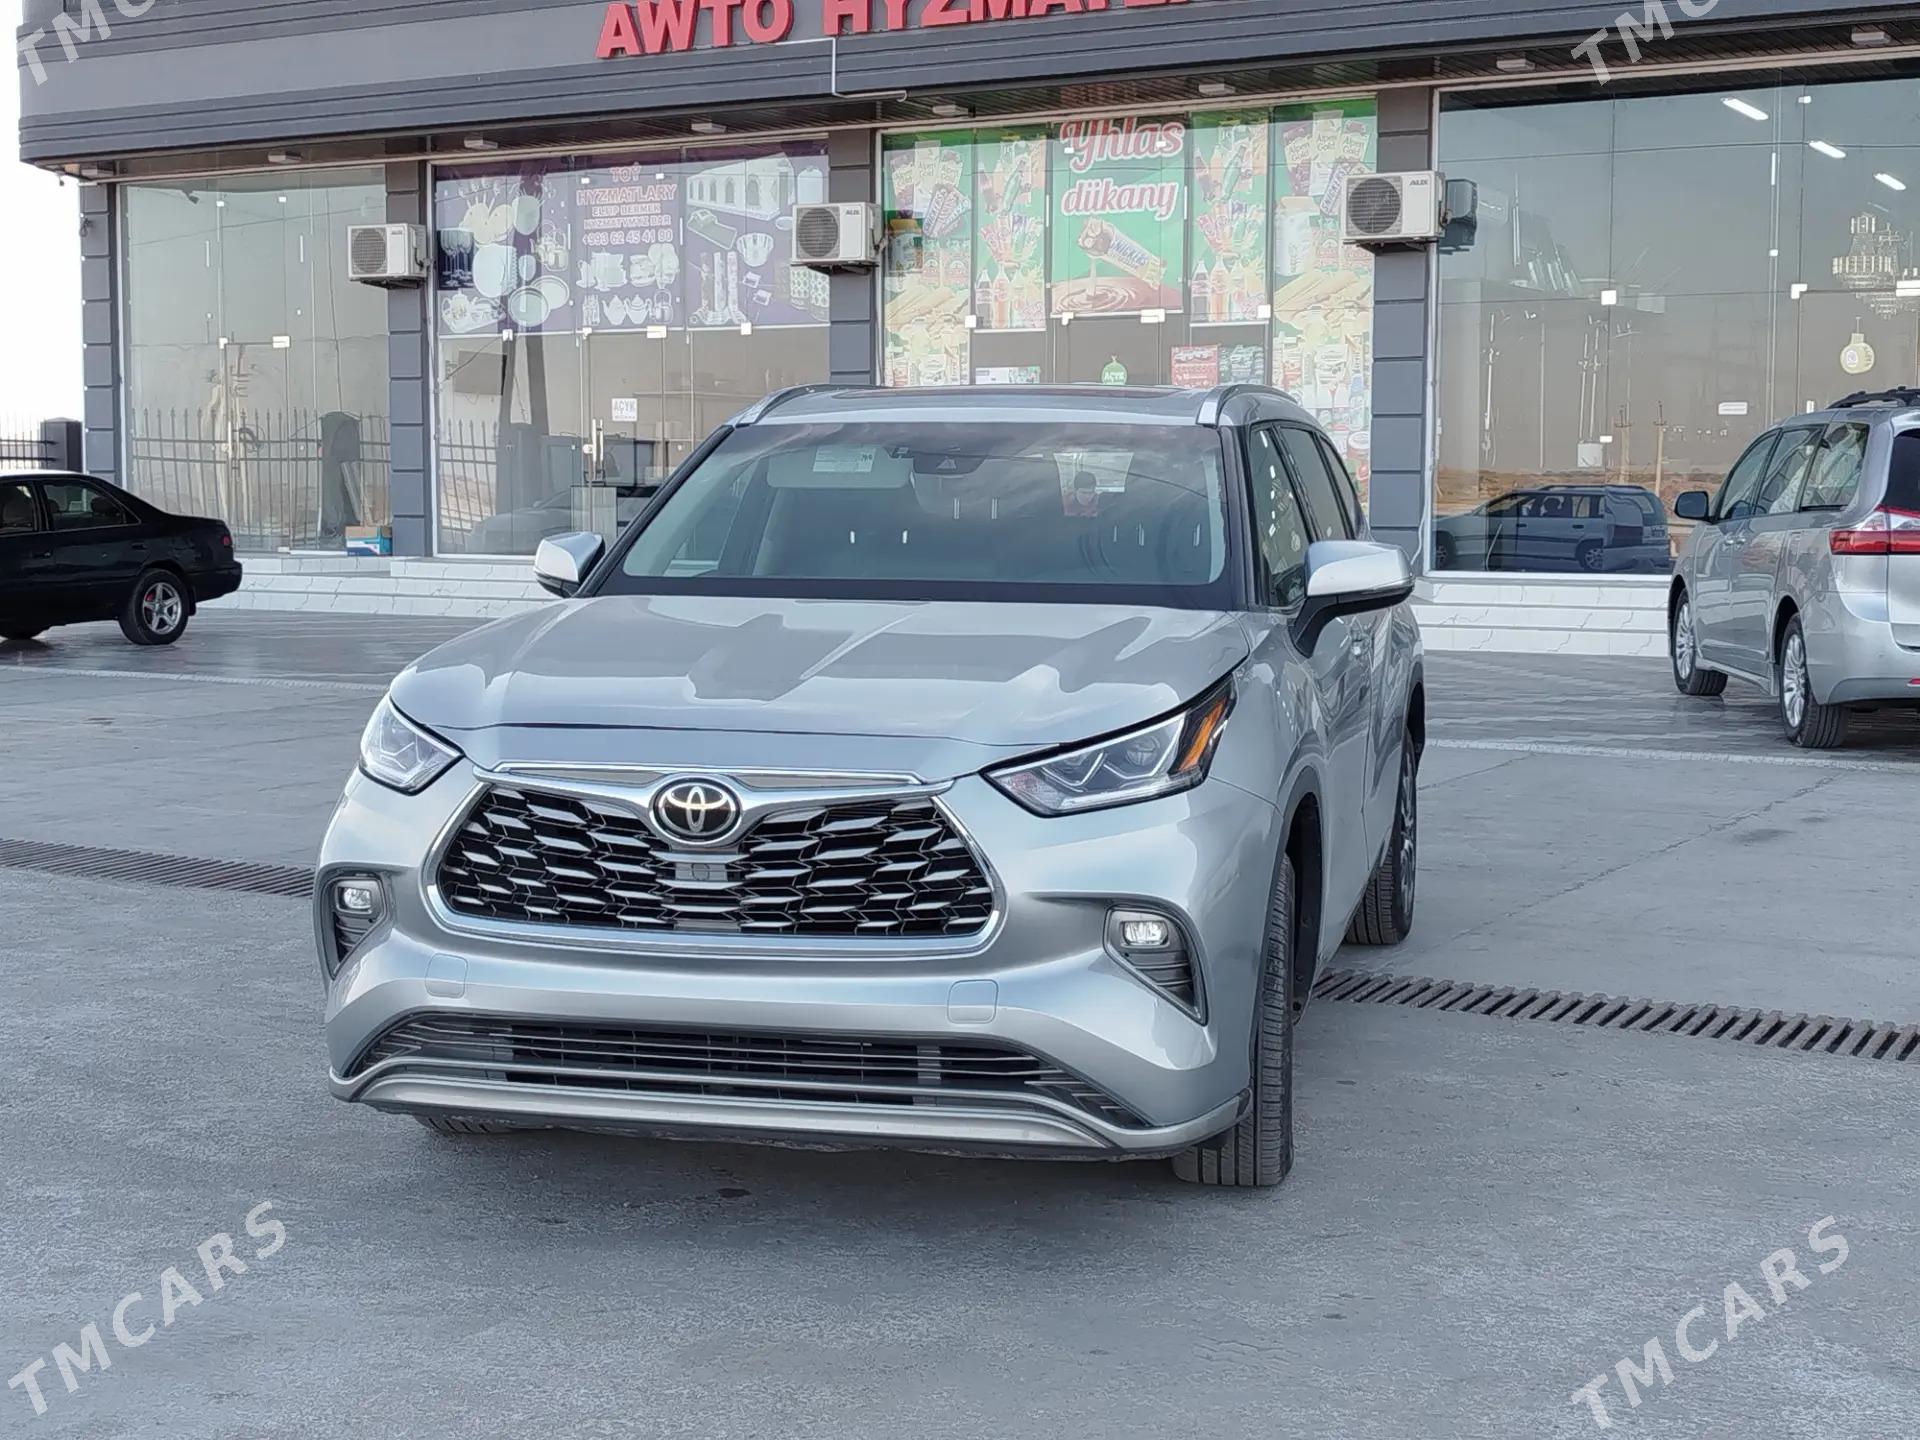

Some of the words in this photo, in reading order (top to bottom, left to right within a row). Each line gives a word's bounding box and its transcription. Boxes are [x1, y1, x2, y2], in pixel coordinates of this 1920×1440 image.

[596, 0, 794, 58] AWTO
[1060, 116, 1185, 173] Yhlas
[576, 184, 678, 206] HYZMATLARY
